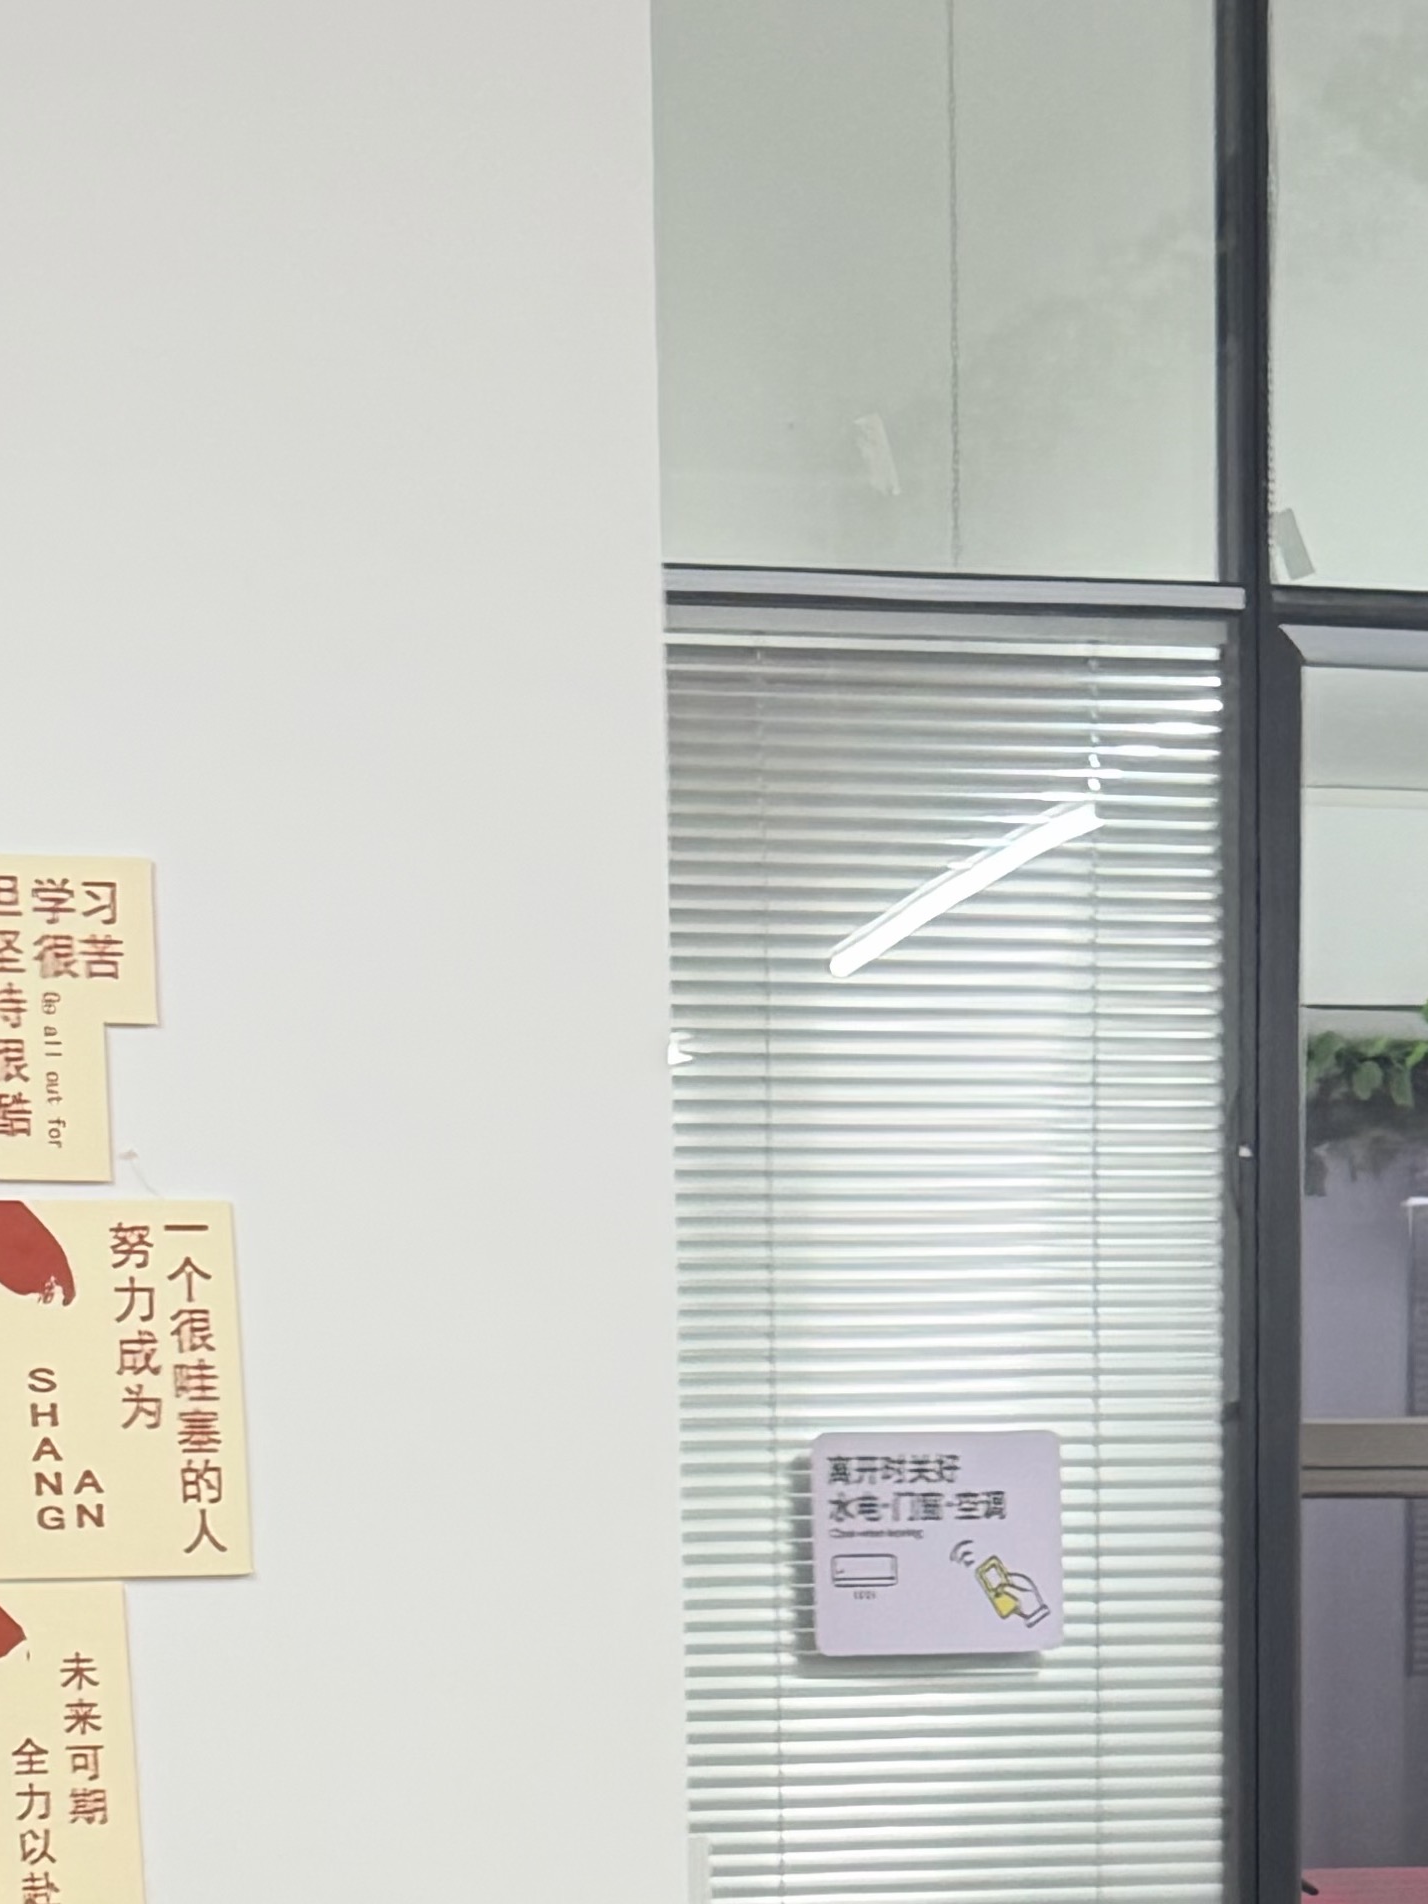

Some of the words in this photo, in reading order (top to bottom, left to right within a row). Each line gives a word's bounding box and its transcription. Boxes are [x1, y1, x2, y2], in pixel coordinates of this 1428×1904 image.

[43, 1025, 63, 1057] all
[45, 1070, 63, 1106] out
[46, 1116, 67, 1149] for
[109, 1221, 163, 1430] 努力成为
[163, 1223, 228, 1554] 一个很哇塞的人
[27, 1367, 67, 1531] SHANG
[826, 1453, 961, 1485] 离开时关好
[73, 1469, 106, 1529] AN
[59, 1651, 109, 1825] 未来可期
